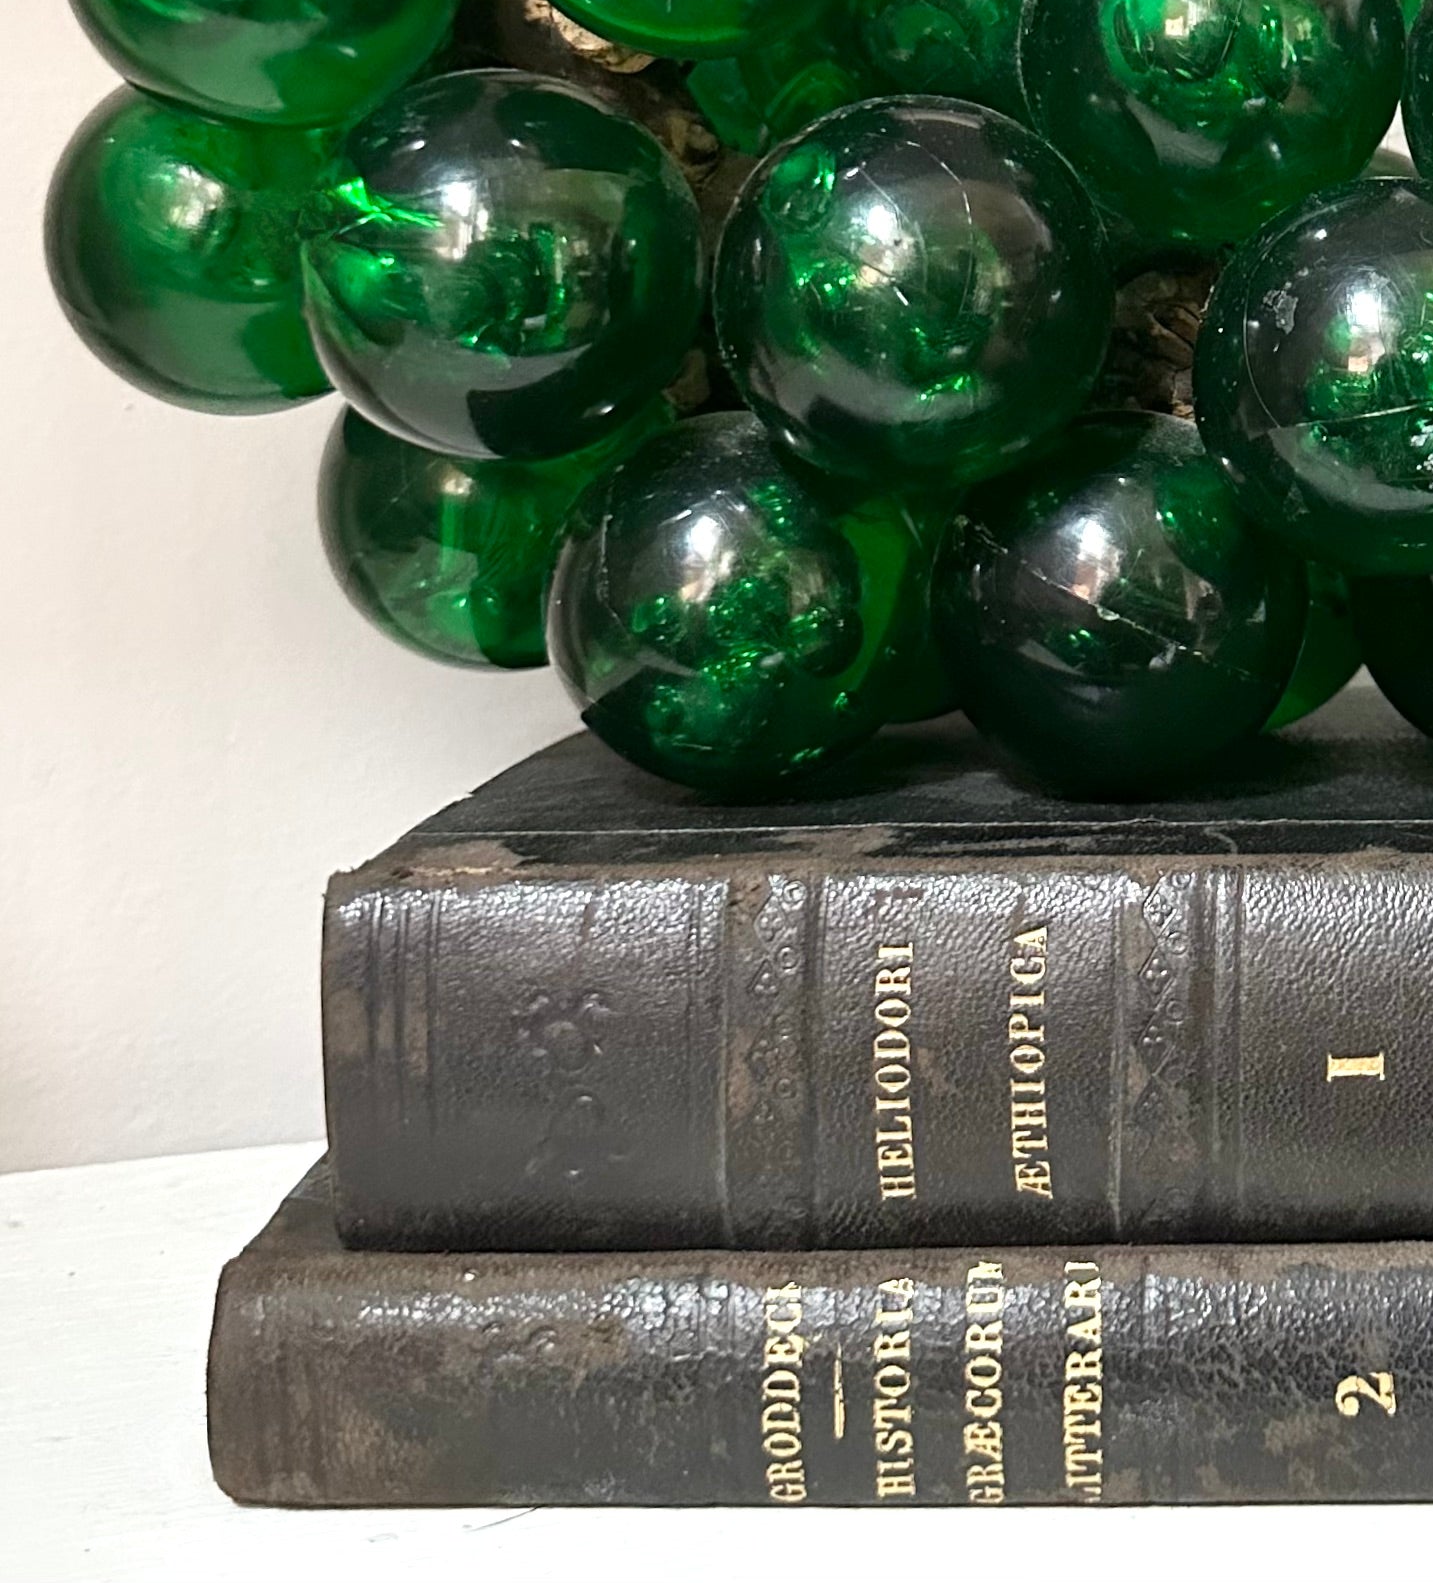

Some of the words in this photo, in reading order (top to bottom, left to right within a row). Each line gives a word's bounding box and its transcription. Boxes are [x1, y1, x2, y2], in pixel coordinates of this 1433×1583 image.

[874, 942, 916, 1201] HELIODORI
[1008, 924, 1053, 1199] ÆTHIOPICA
[873, 1277, 917, 1498] HISTORIA
[1063, 1261, 1103, 1503] ITTERARI
[1335, 1371, 1396, 1417] 2
